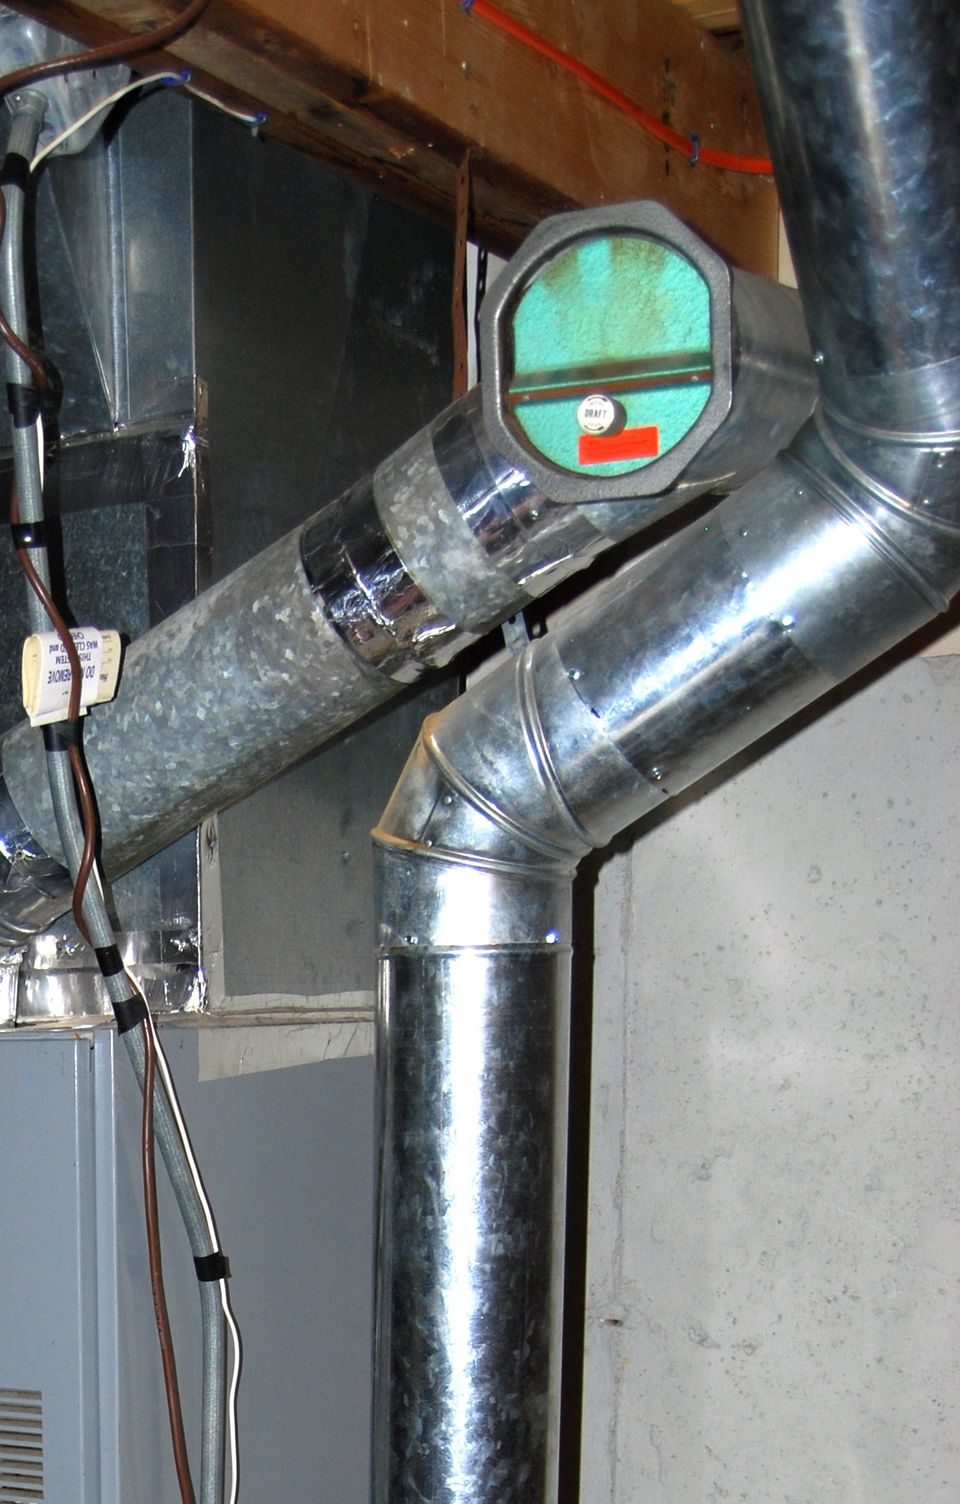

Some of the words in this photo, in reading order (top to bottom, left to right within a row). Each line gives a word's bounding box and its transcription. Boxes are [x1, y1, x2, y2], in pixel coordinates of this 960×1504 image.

[584, 409, 607, 419] DRAFT
[49, 644, 59, 655] and
[86, 640, 98, 650] WAS
[47, 669, 71, 684] REMOVE
[85, 666, 96, 679] DO
